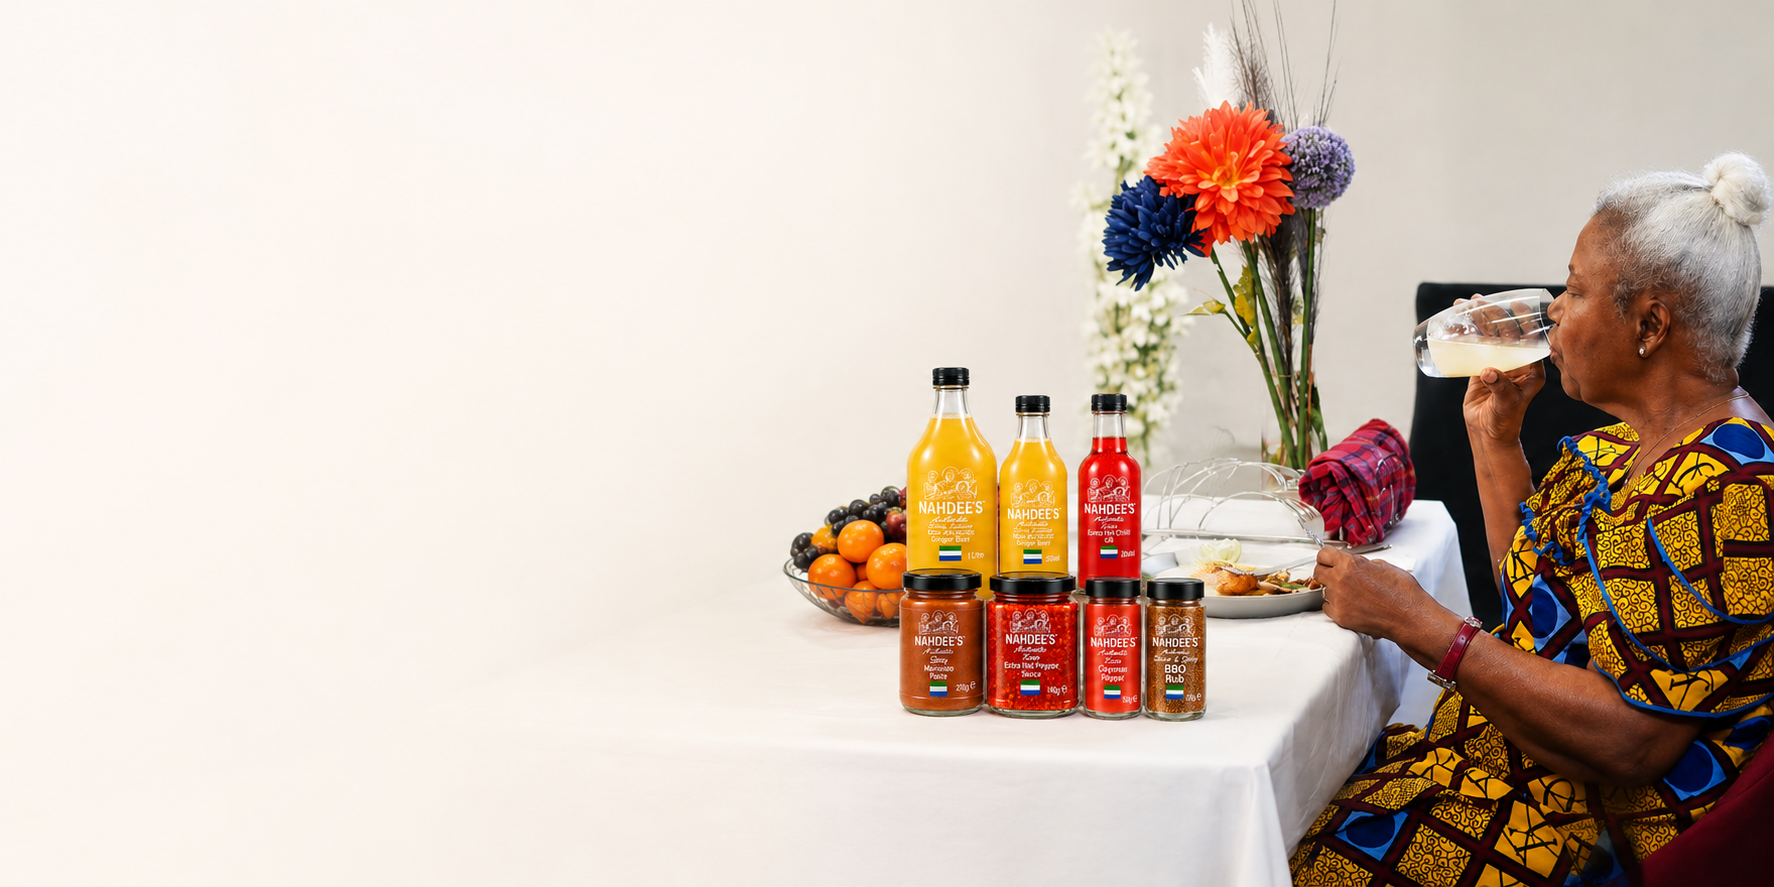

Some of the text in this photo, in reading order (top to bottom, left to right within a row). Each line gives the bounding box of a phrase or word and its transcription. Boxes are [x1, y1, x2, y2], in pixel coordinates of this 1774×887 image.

[919, 501, 983, 515] NAHDEE'S
[914, 635, 964, 647] NAHDEE'S
[1005, 633, 1058, 645] NAHDEE'S
